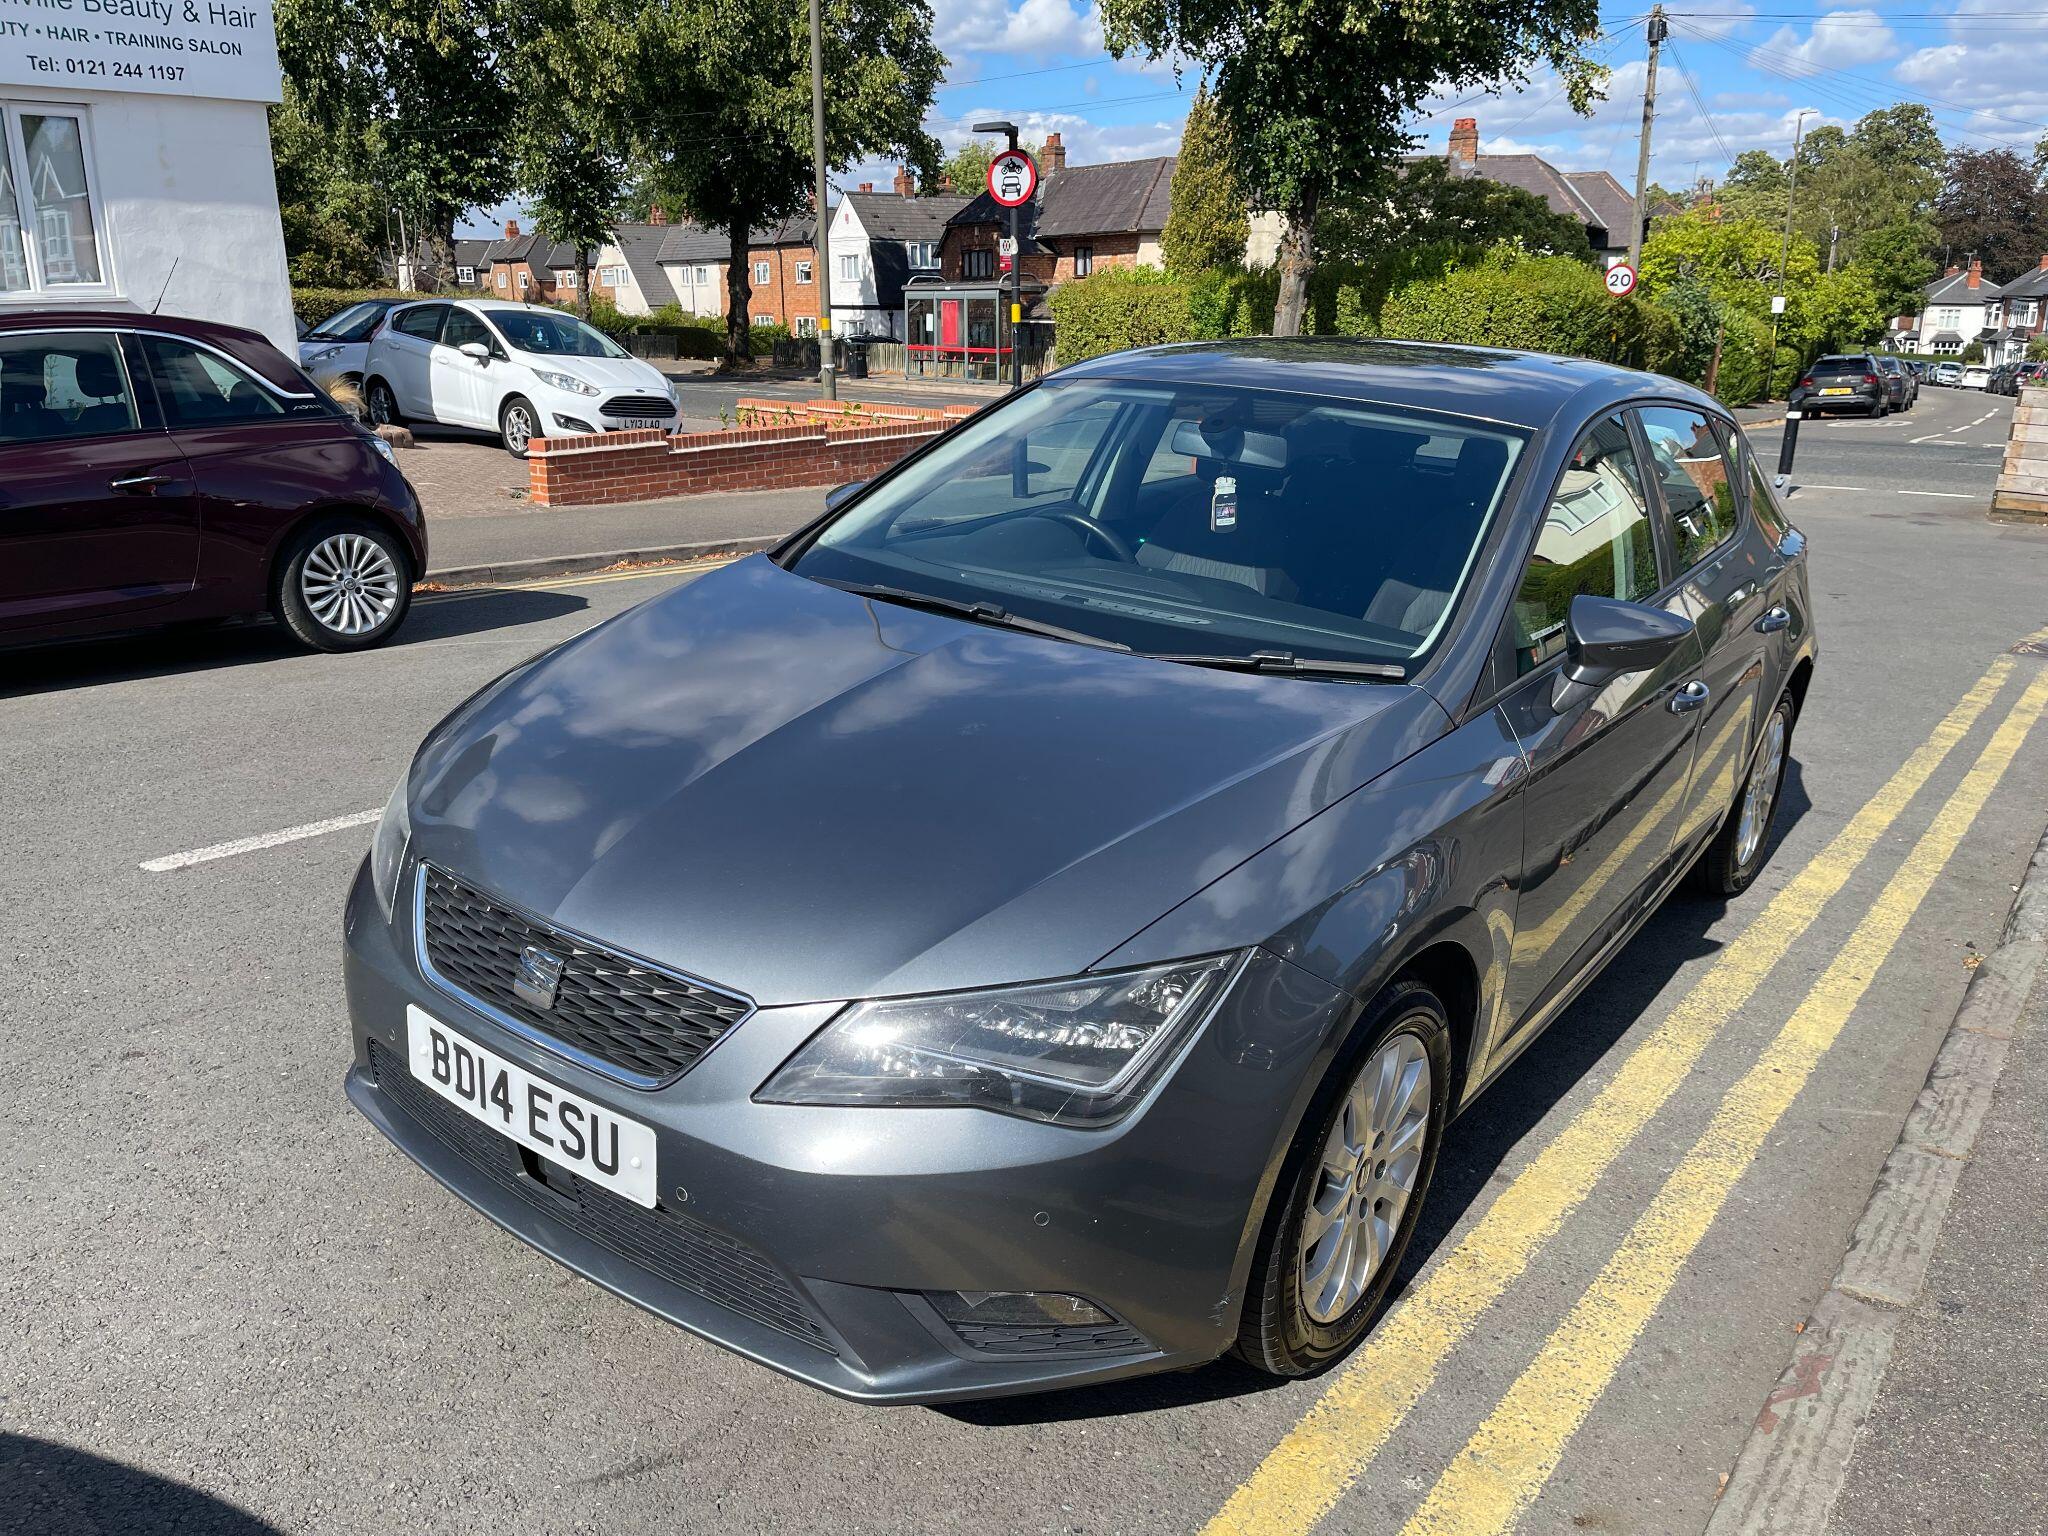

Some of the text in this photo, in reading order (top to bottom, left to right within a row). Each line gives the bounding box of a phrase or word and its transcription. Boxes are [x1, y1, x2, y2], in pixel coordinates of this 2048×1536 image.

[84, 0, 257, 28] Beauty & Hair
[46, 25, 90, 43] HAIR
[104, 31, 184, 51] TRAINING
[188, 39, 242, 56] SALON
[26, 55, 184, 81] Tel: 0121 244 1197
[1609, 274, 1631, 286] 20
[429, 1027, 619, 1176] BD14 ESU
